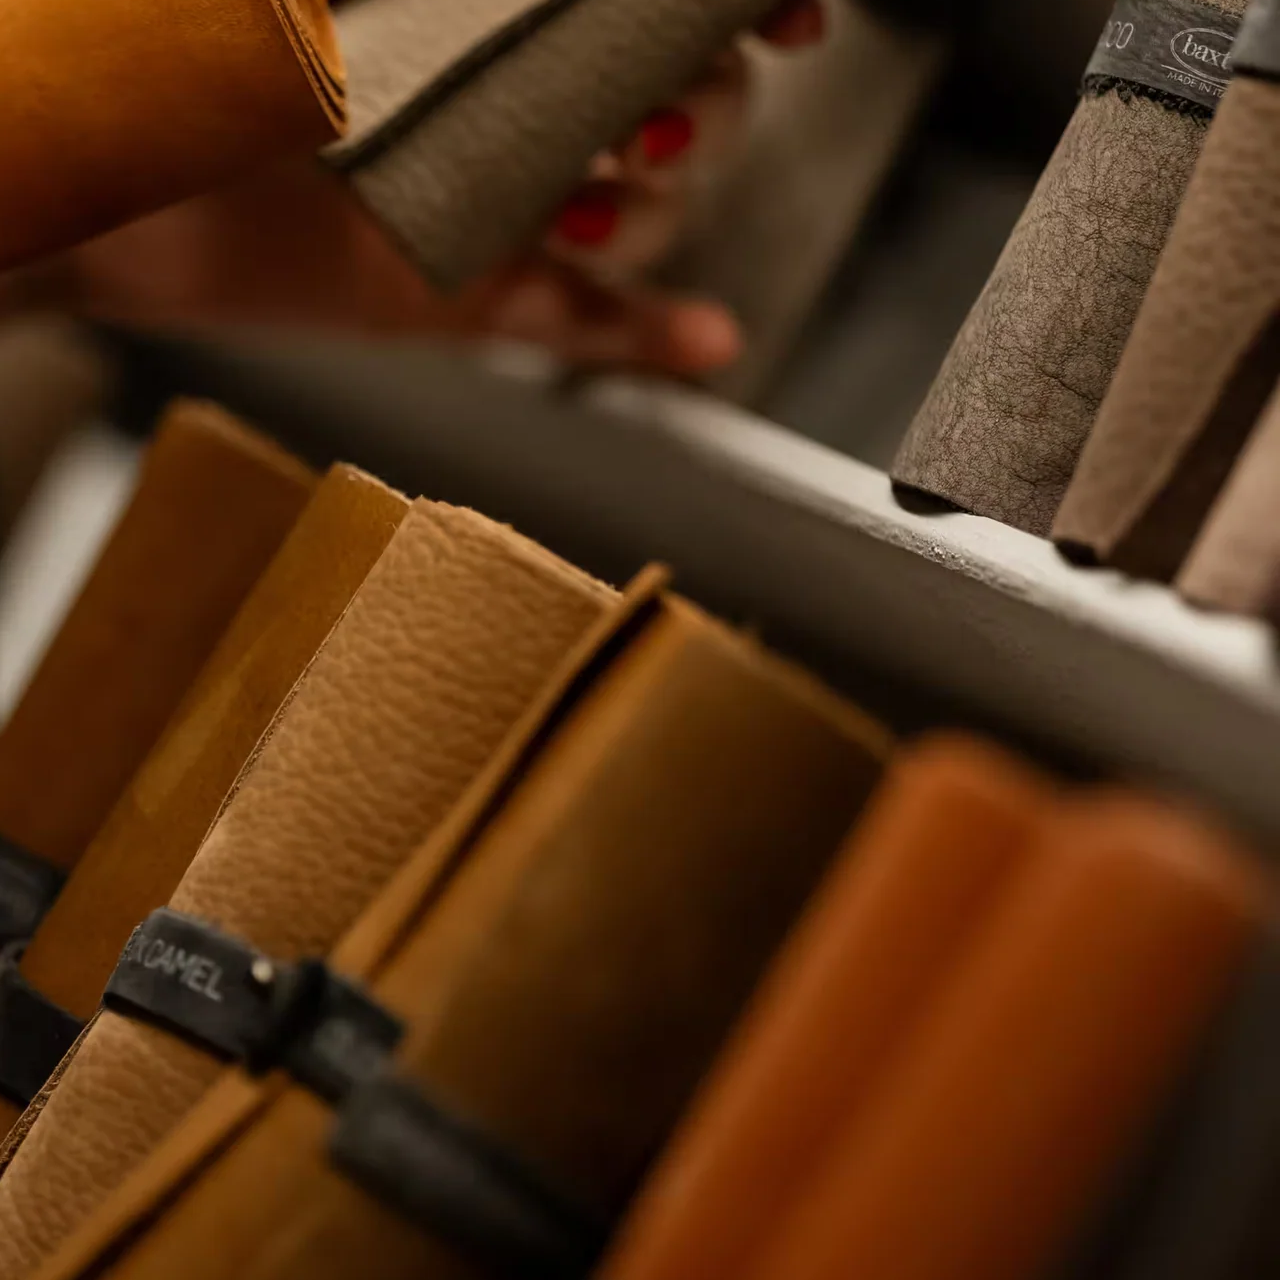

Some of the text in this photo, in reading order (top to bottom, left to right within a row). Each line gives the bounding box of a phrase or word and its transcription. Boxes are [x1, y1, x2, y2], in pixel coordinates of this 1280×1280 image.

[1182, 34, 1233, 70] baxt
[1166, 71, 1197, 88] MADE
[1198, 81, 1212, 93] IN
[143, 938, 223, 1002] CAMEL
